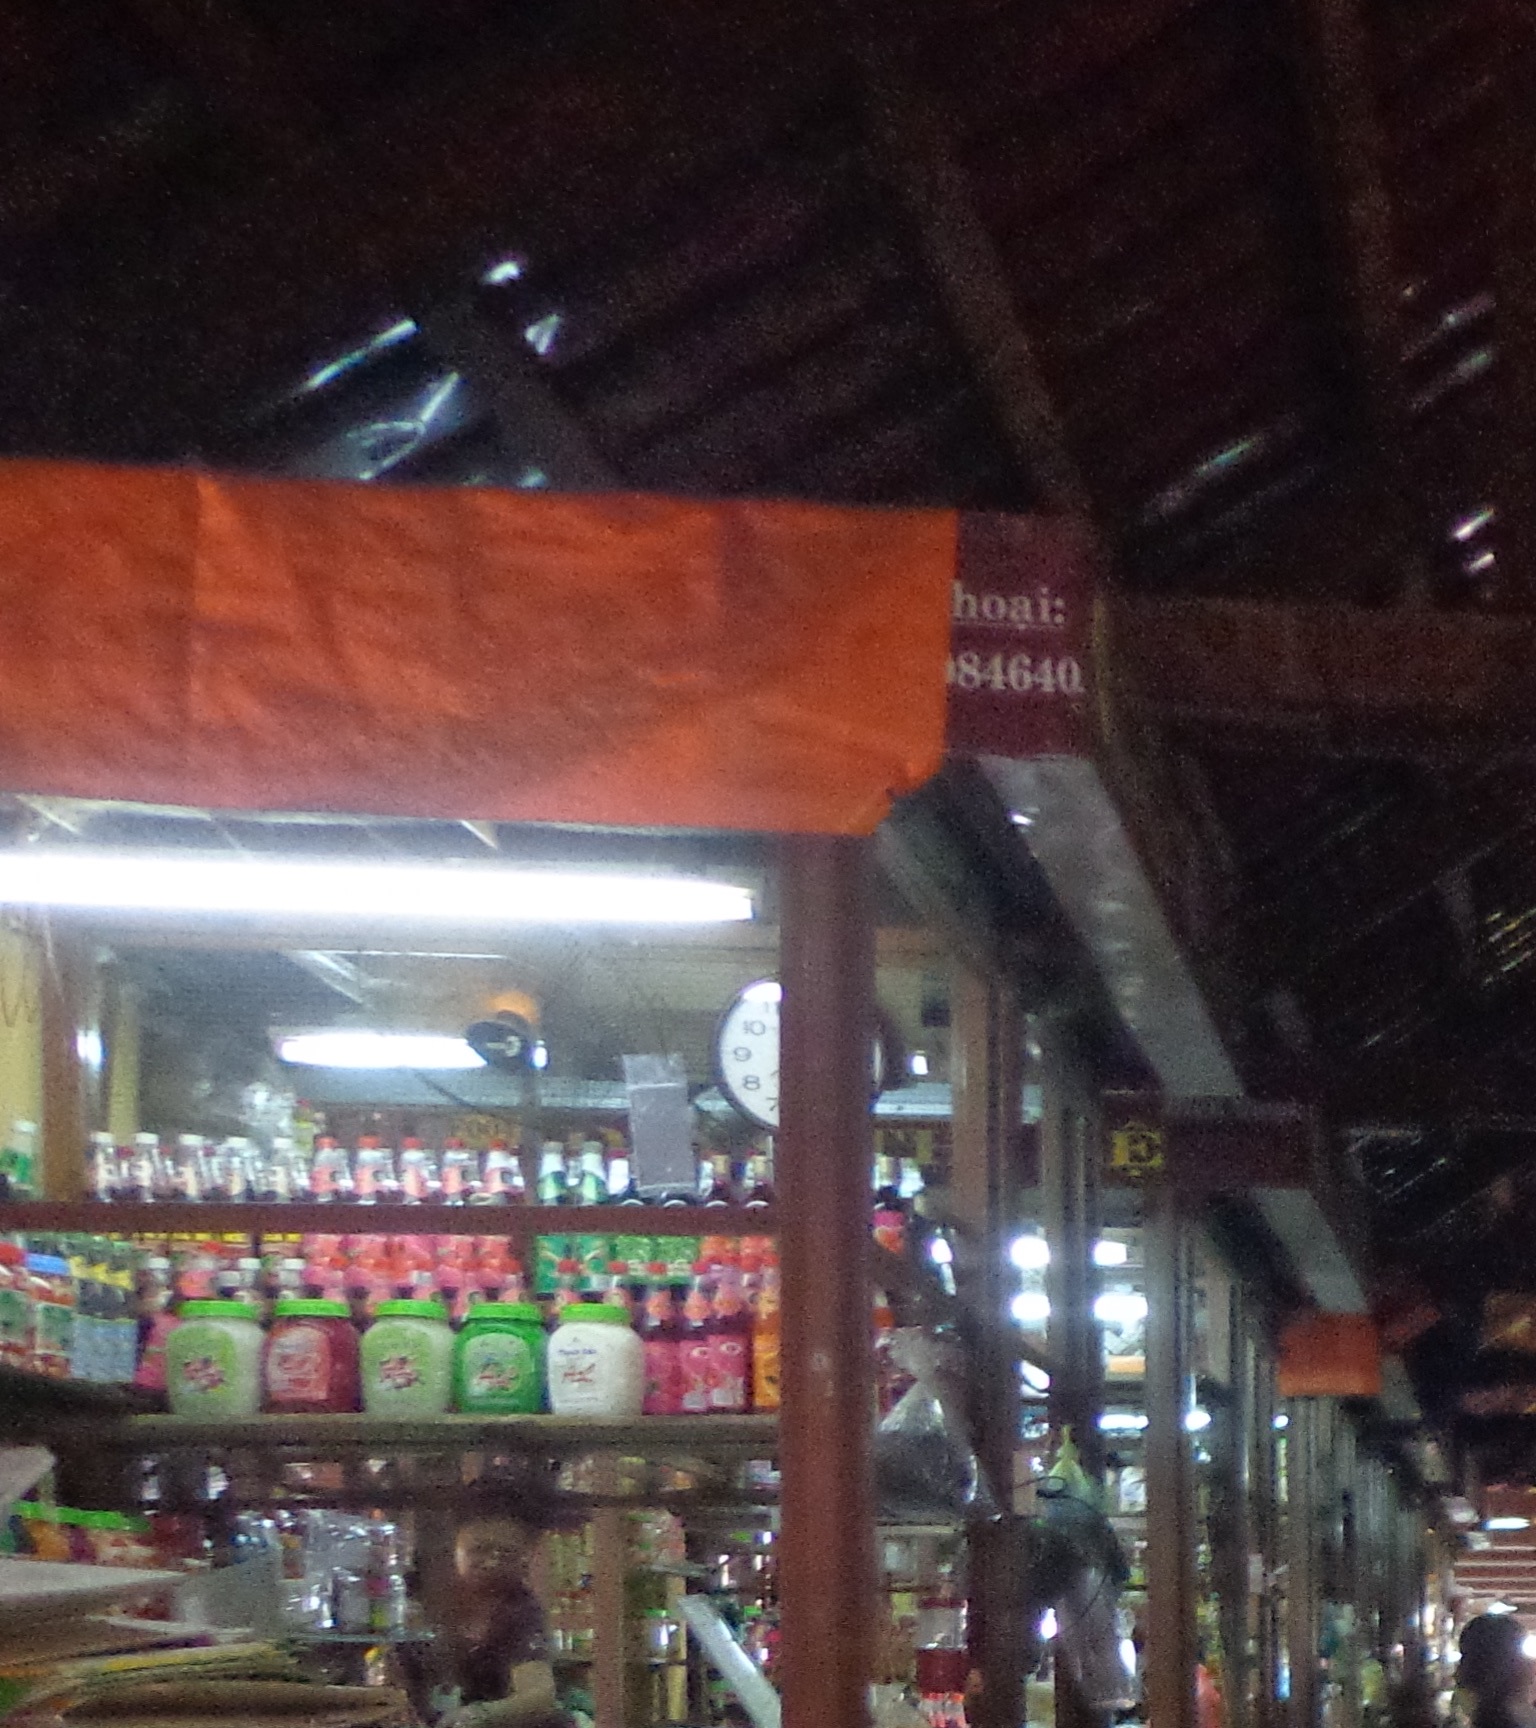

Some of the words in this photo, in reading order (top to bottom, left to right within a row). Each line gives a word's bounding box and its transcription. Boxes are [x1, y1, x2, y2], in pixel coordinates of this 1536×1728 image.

[742, 1019, 767, 1037] 10
[732, 1046, 752, 1063] 9
[743, 1074, 761, 1091] 8
